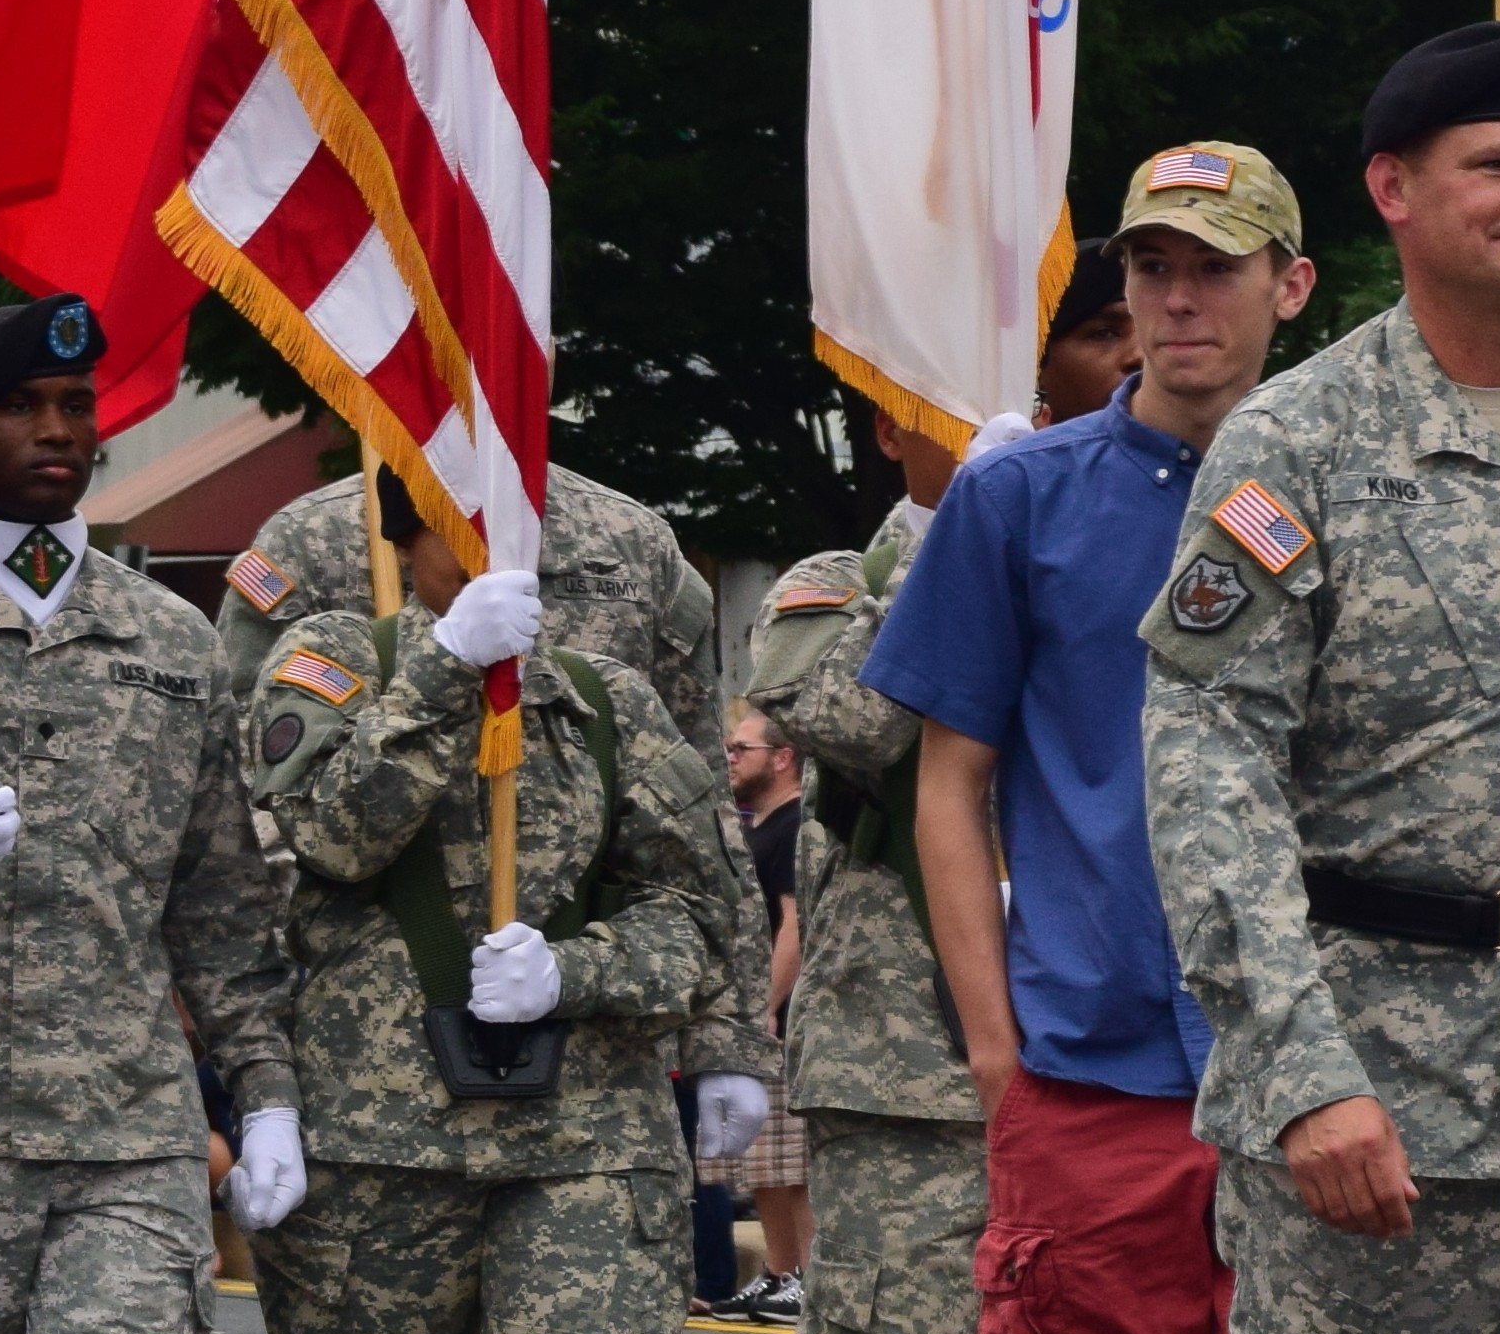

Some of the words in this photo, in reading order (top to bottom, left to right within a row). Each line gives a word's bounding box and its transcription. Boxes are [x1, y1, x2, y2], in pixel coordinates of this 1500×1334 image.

[1366, 476, 1419, 501] KING
[596, 579, 639, 598] ARMY
[153, 669, 199, 697] ARMY
